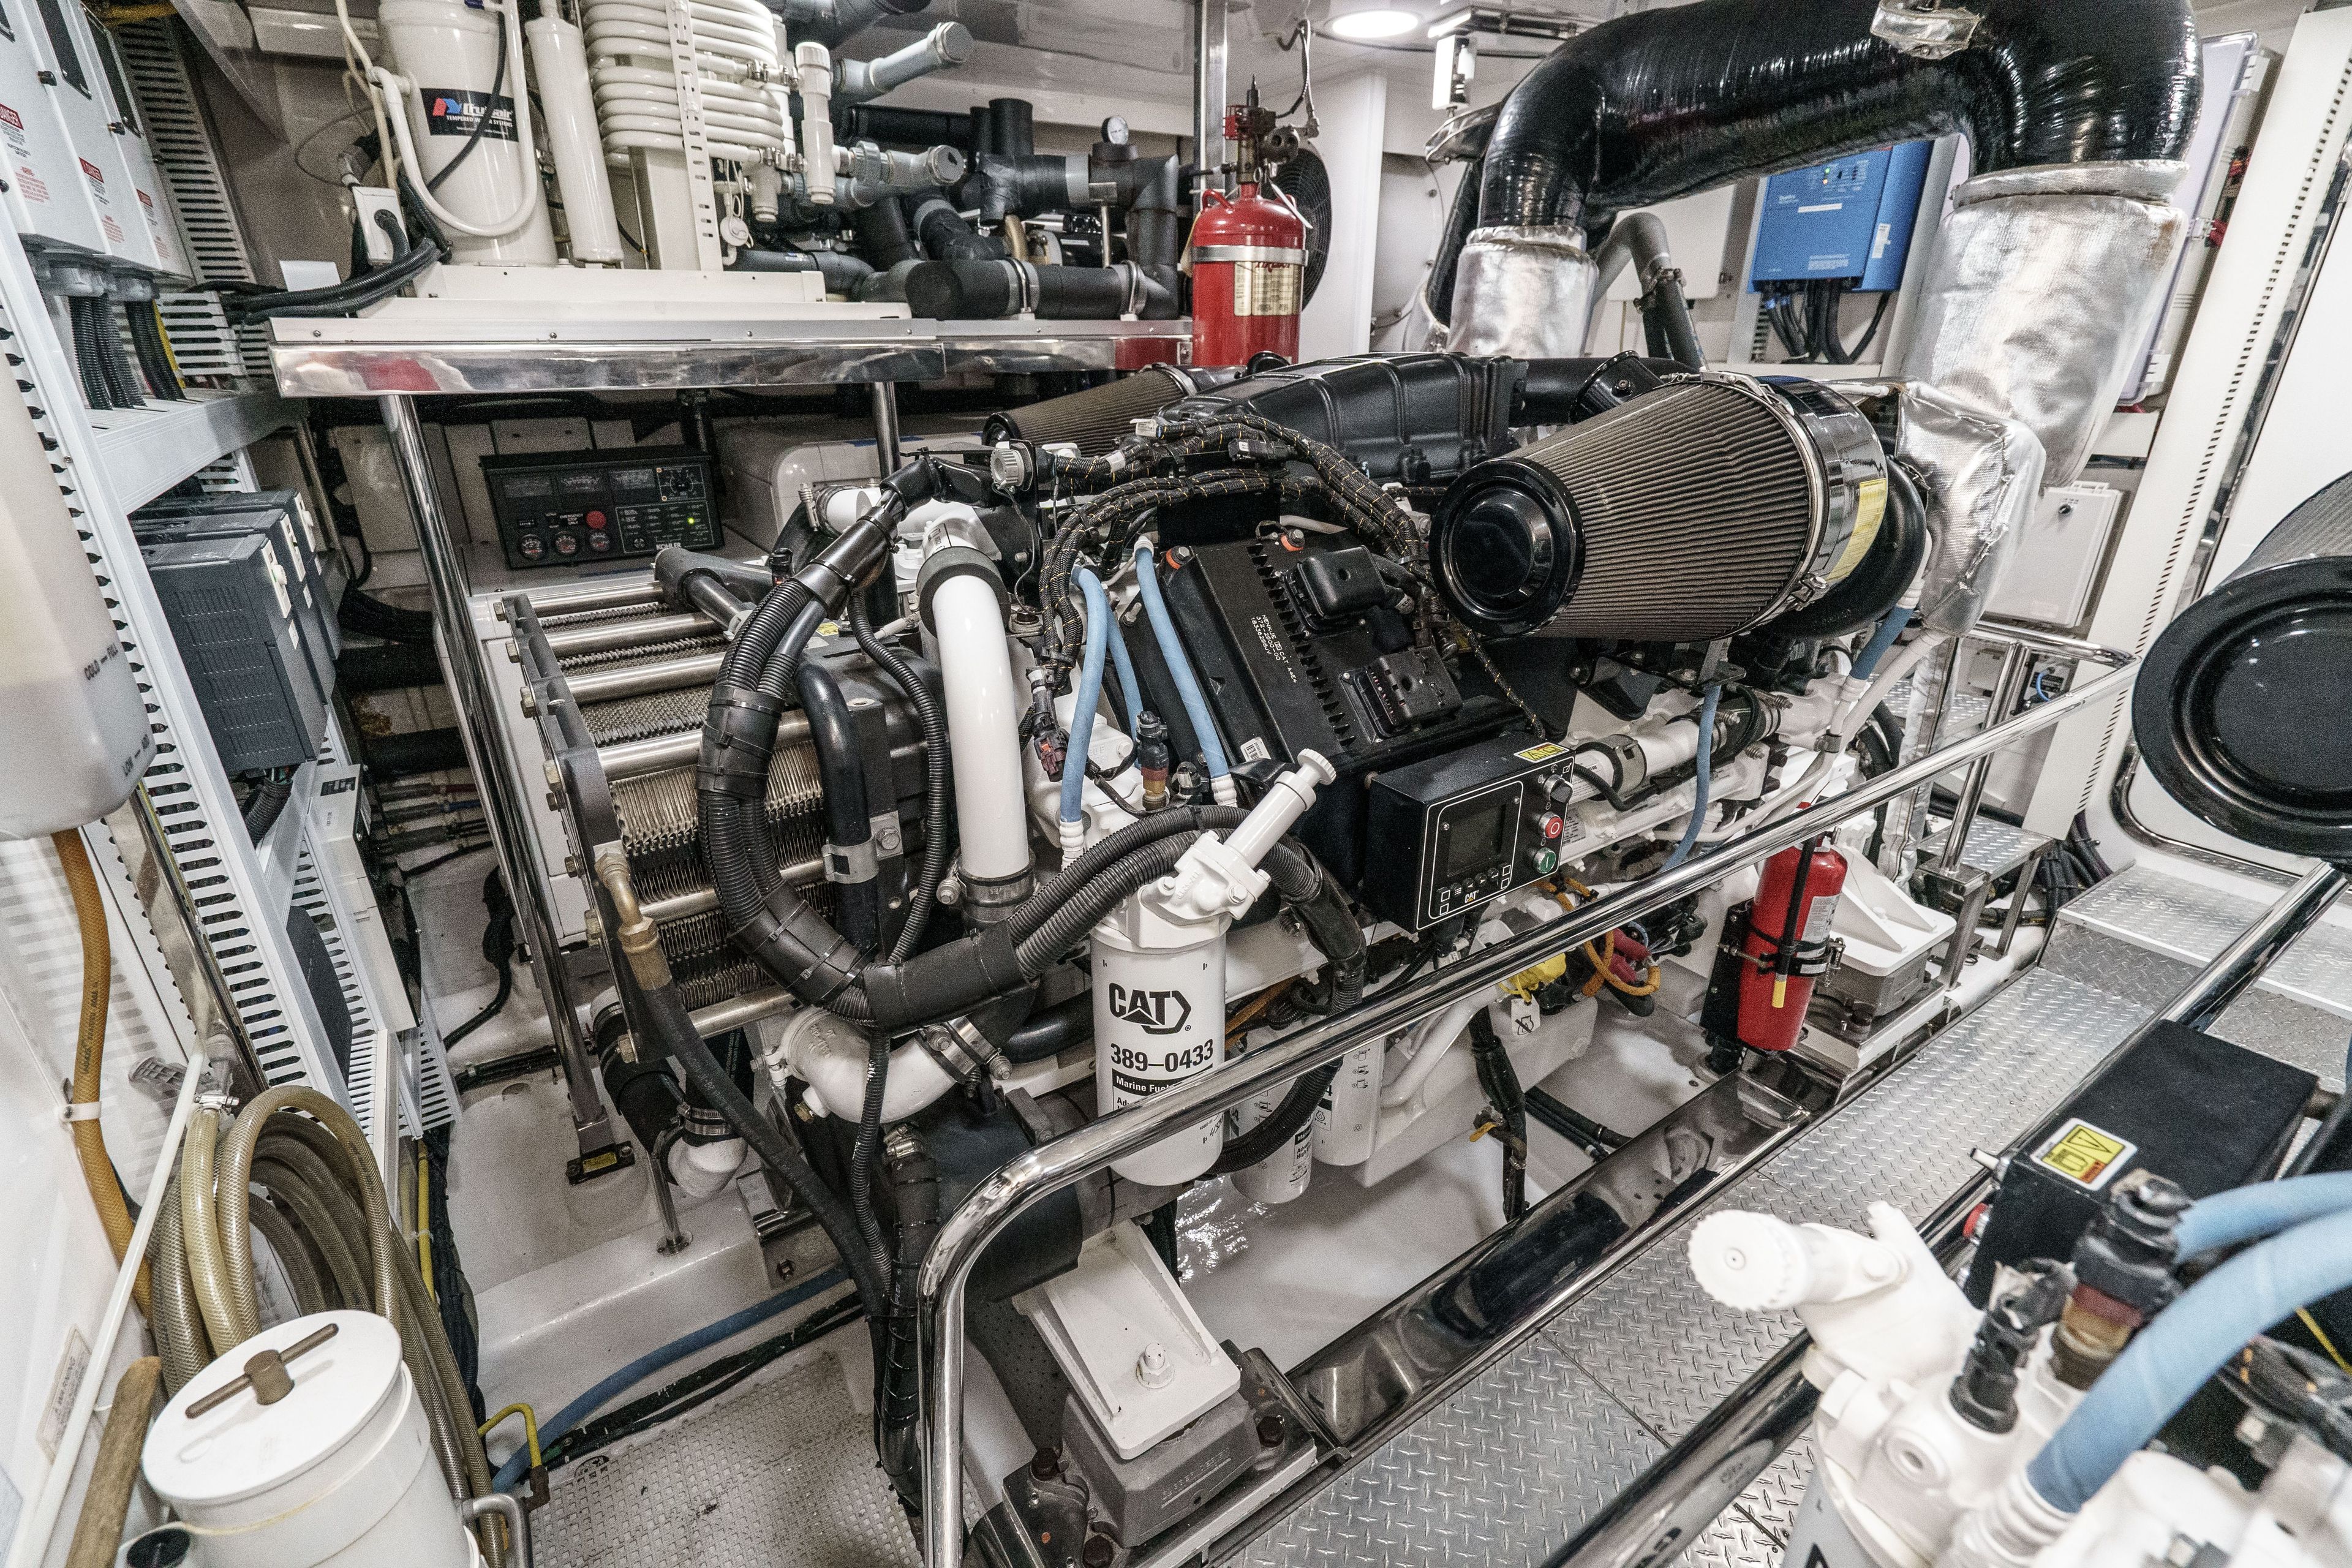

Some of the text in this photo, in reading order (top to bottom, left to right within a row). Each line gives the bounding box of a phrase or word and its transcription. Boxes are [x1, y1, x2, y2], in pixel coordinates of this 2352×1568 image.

[1256, 616, 1281, 661] 372-2900-00
[1280, 651, 1289, 664] CAT
[84, 660, 100, 680] COLD
[1464, 890, 1477, 903] CAT
[1109, 982, 1171, 1025] CAT
[1111, 1038, 1213, 1072] 389-0433
[1116, 1076, 1169, 1093] Marine Fue
